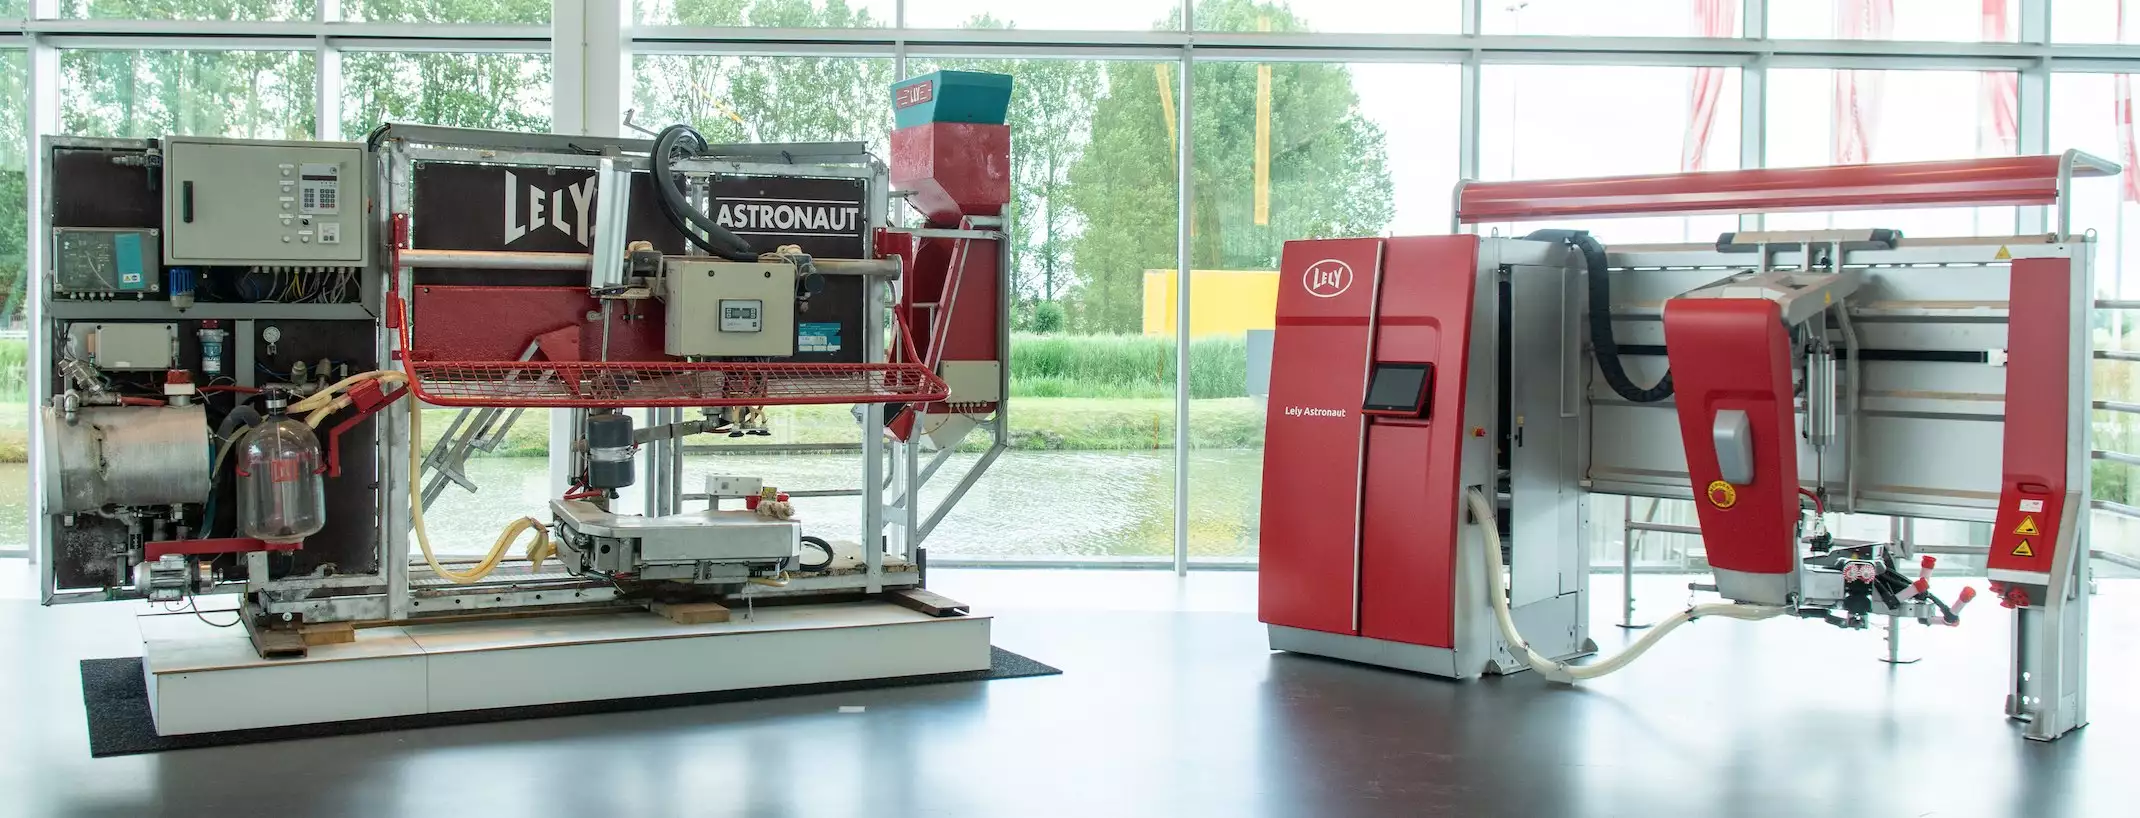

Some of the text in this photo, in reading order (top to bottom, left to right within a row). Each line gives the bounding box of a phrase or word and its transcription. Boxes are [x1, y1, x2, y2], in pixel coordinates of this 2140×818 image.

[505, 170, 595, 247] LELY
[716, 204, 859, 231] ASTRONAUT
[1313, 266, 1343, 290] LELY
[1285, 406, 1346, 417] Lely Astronaut
